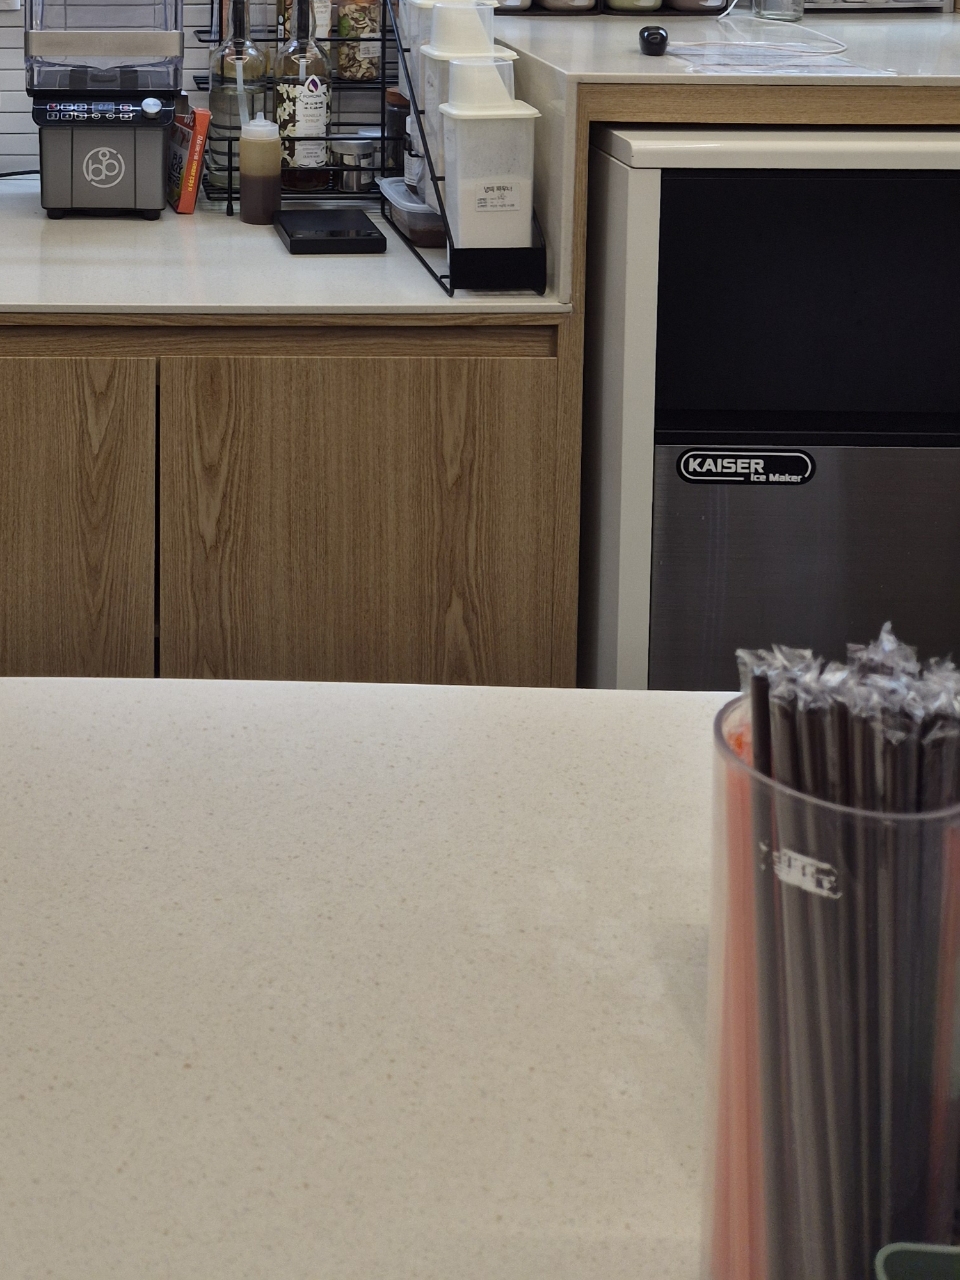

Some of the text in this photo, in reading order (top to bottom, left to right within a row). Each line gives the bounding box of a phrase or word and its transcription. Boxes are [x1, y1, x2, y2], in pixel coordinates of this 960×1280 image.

[688, 458, 764, 473] KAISER
[750, 473, 803, 482] Ice Maker
